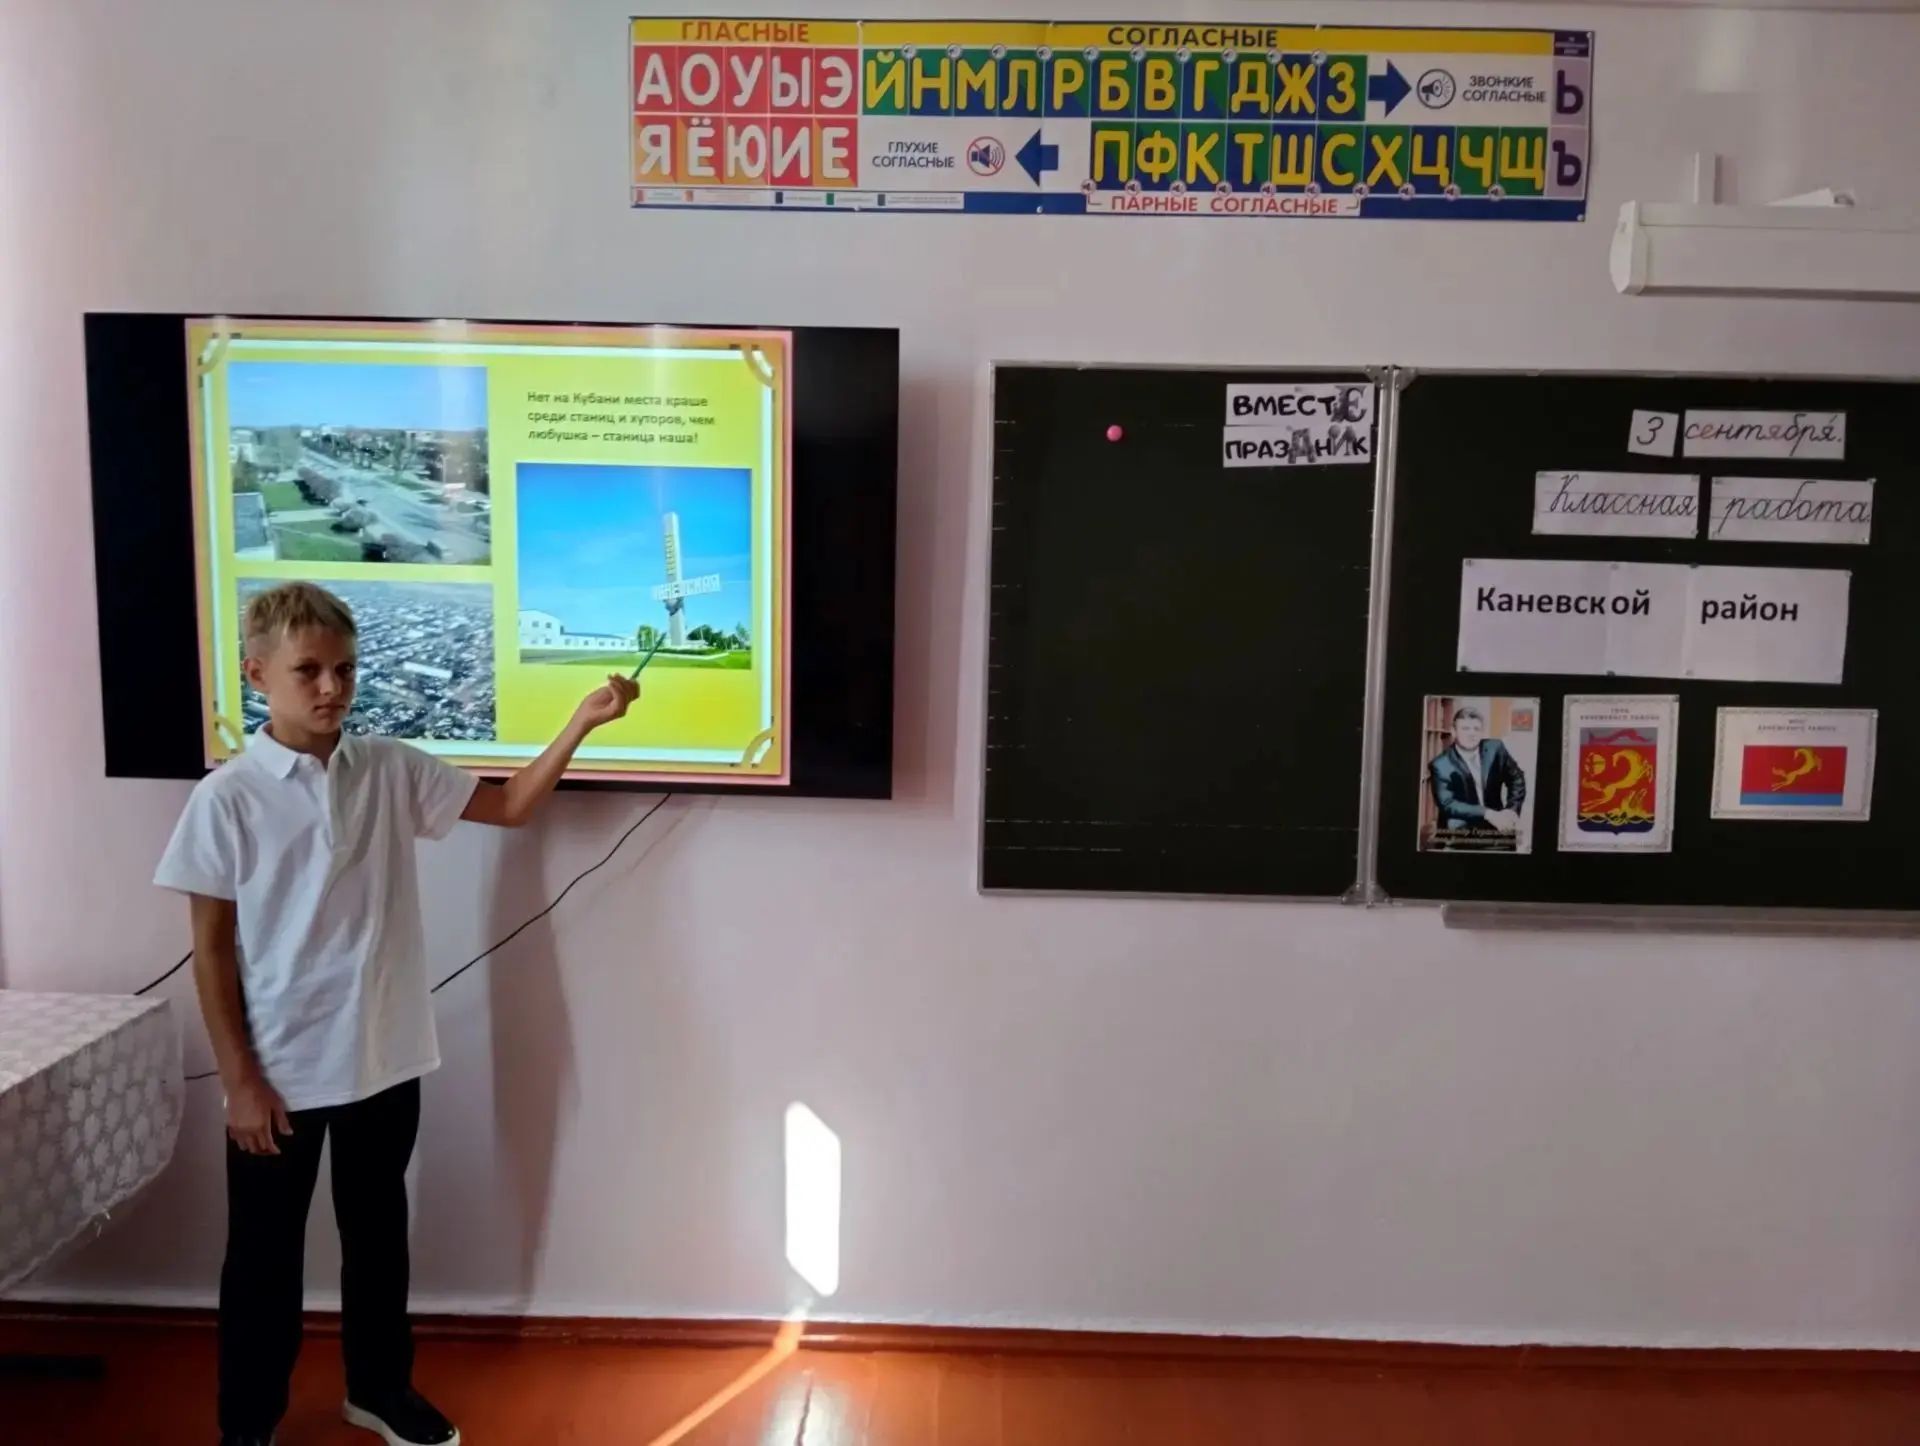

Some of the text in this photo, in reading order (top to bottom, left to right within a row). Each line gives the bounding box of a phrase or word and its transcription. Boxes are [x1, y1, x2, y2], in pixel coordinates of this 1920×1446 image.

[682, 21, 809, 43] ГЛАСНЫЕ
[1107, 26, 1278, 48] СОГЛАСНЫЕ
[1469, 75, 1534, 88] ЗВОНКИЕ
[1462, 89, 1546, 103] СОГЛАСНЫЕ
[888, 141, 938, 153] ГЛУХИЕ
[872, 156, 955, 168] СОГЛАСНЫЕ
[1111, 195, 1338, 214] ПАРНЫЕ СОГЛАСНЫЕ
[528, 392, 708, 408] Нет на Кубани места краше
[1233, 385, 1368, 423] ВМЕСТЕ
[528, 411, 715, 426] среди станиц и хуторов, чем
[528, 429, 588, 443] любушка
[603, 432, 655, 444] станица
[659, 432, 698, 444] наша!
[1637, 416, 1664, 445] 3
[1225, 424, 1369, 465] ПРАЗДНИК
[1551, 473, 1697, 516] Классная
[1476, 587, 1799, 624] Каневской район
